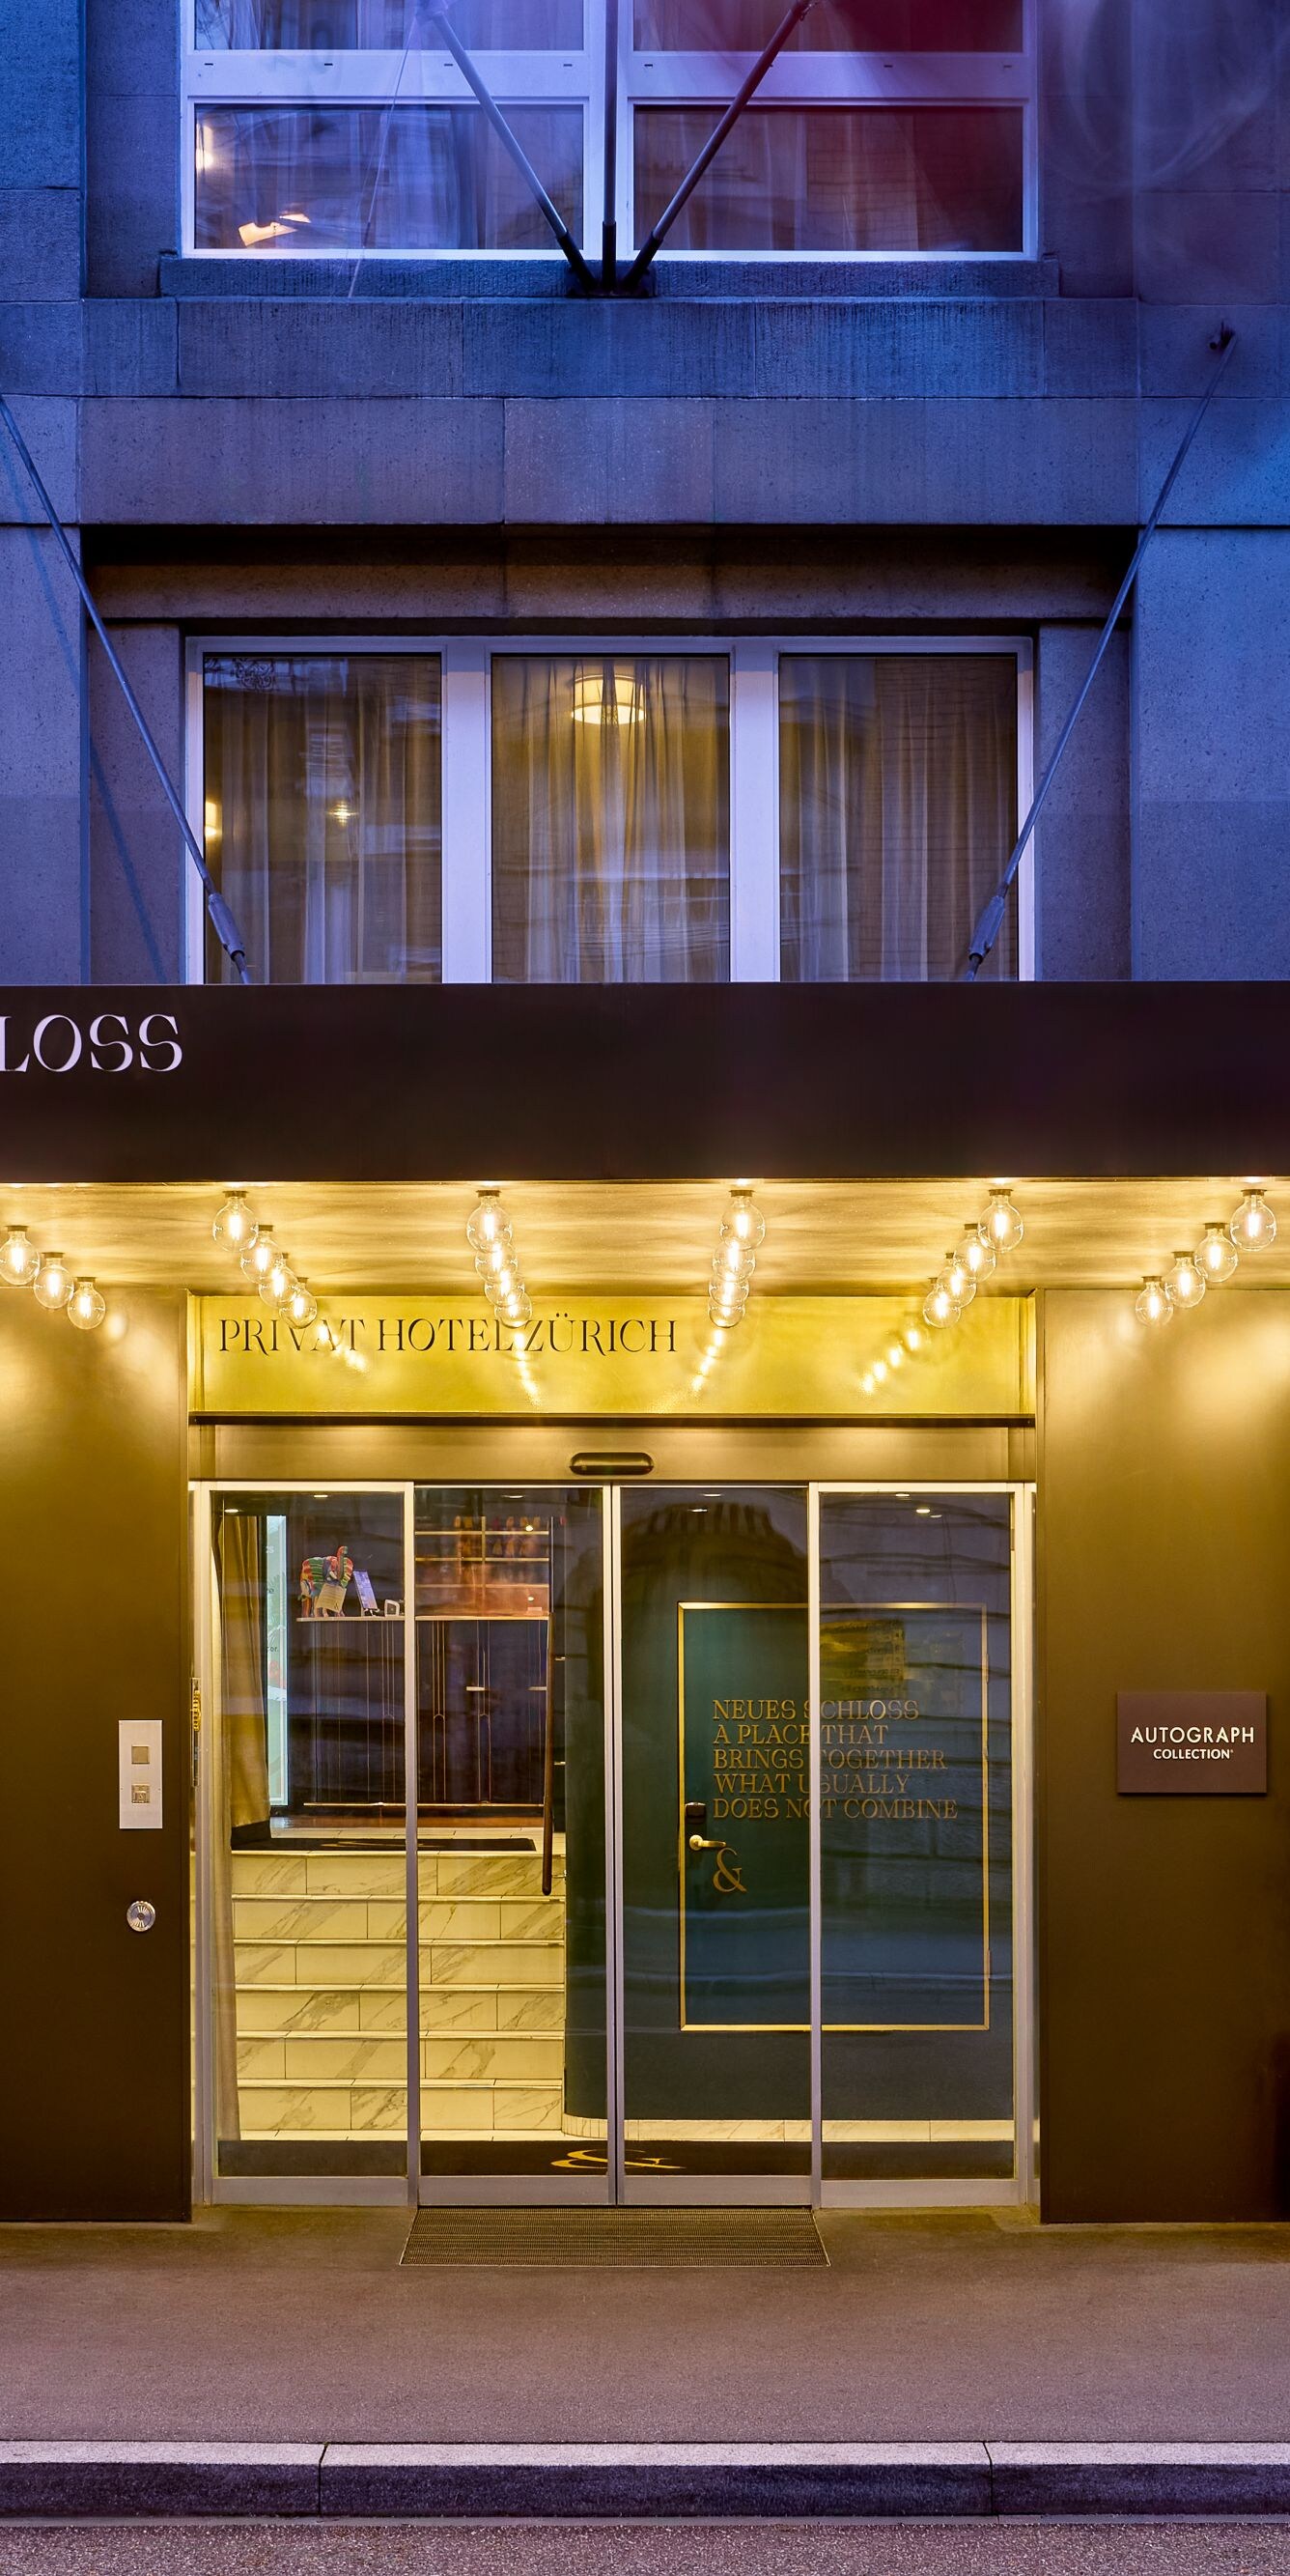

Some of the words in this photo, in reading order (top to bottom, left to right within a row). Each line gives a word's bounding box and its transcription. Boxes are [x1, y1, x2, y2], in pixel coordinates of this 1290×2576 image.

[0, 1013, 183, 1073] LOSS
[218, 1317, 366, 1357] PRIVAT
[377, 1318, 514, 1351] HOTEL
[523, 1313, 677, 1357] ZÜRICH
[713, 1699, 797, 1720] NEUES
[713, 1724, 732, 1745] A
[737, 1724, 810, 1745] PLACE
[821, 1724, 888, 1745] THAT
[1130, 1726, 1254, 1743] AUTOGRAPH
[713, 1748, 804, 1769] BRINGS
[714, 1773, 791, 1794] WHAT
[713, 1798, 779, 1819] DOES
[844, 1798, 958, 1819] COMBINE
[712, 1847, 747, 1893] &
